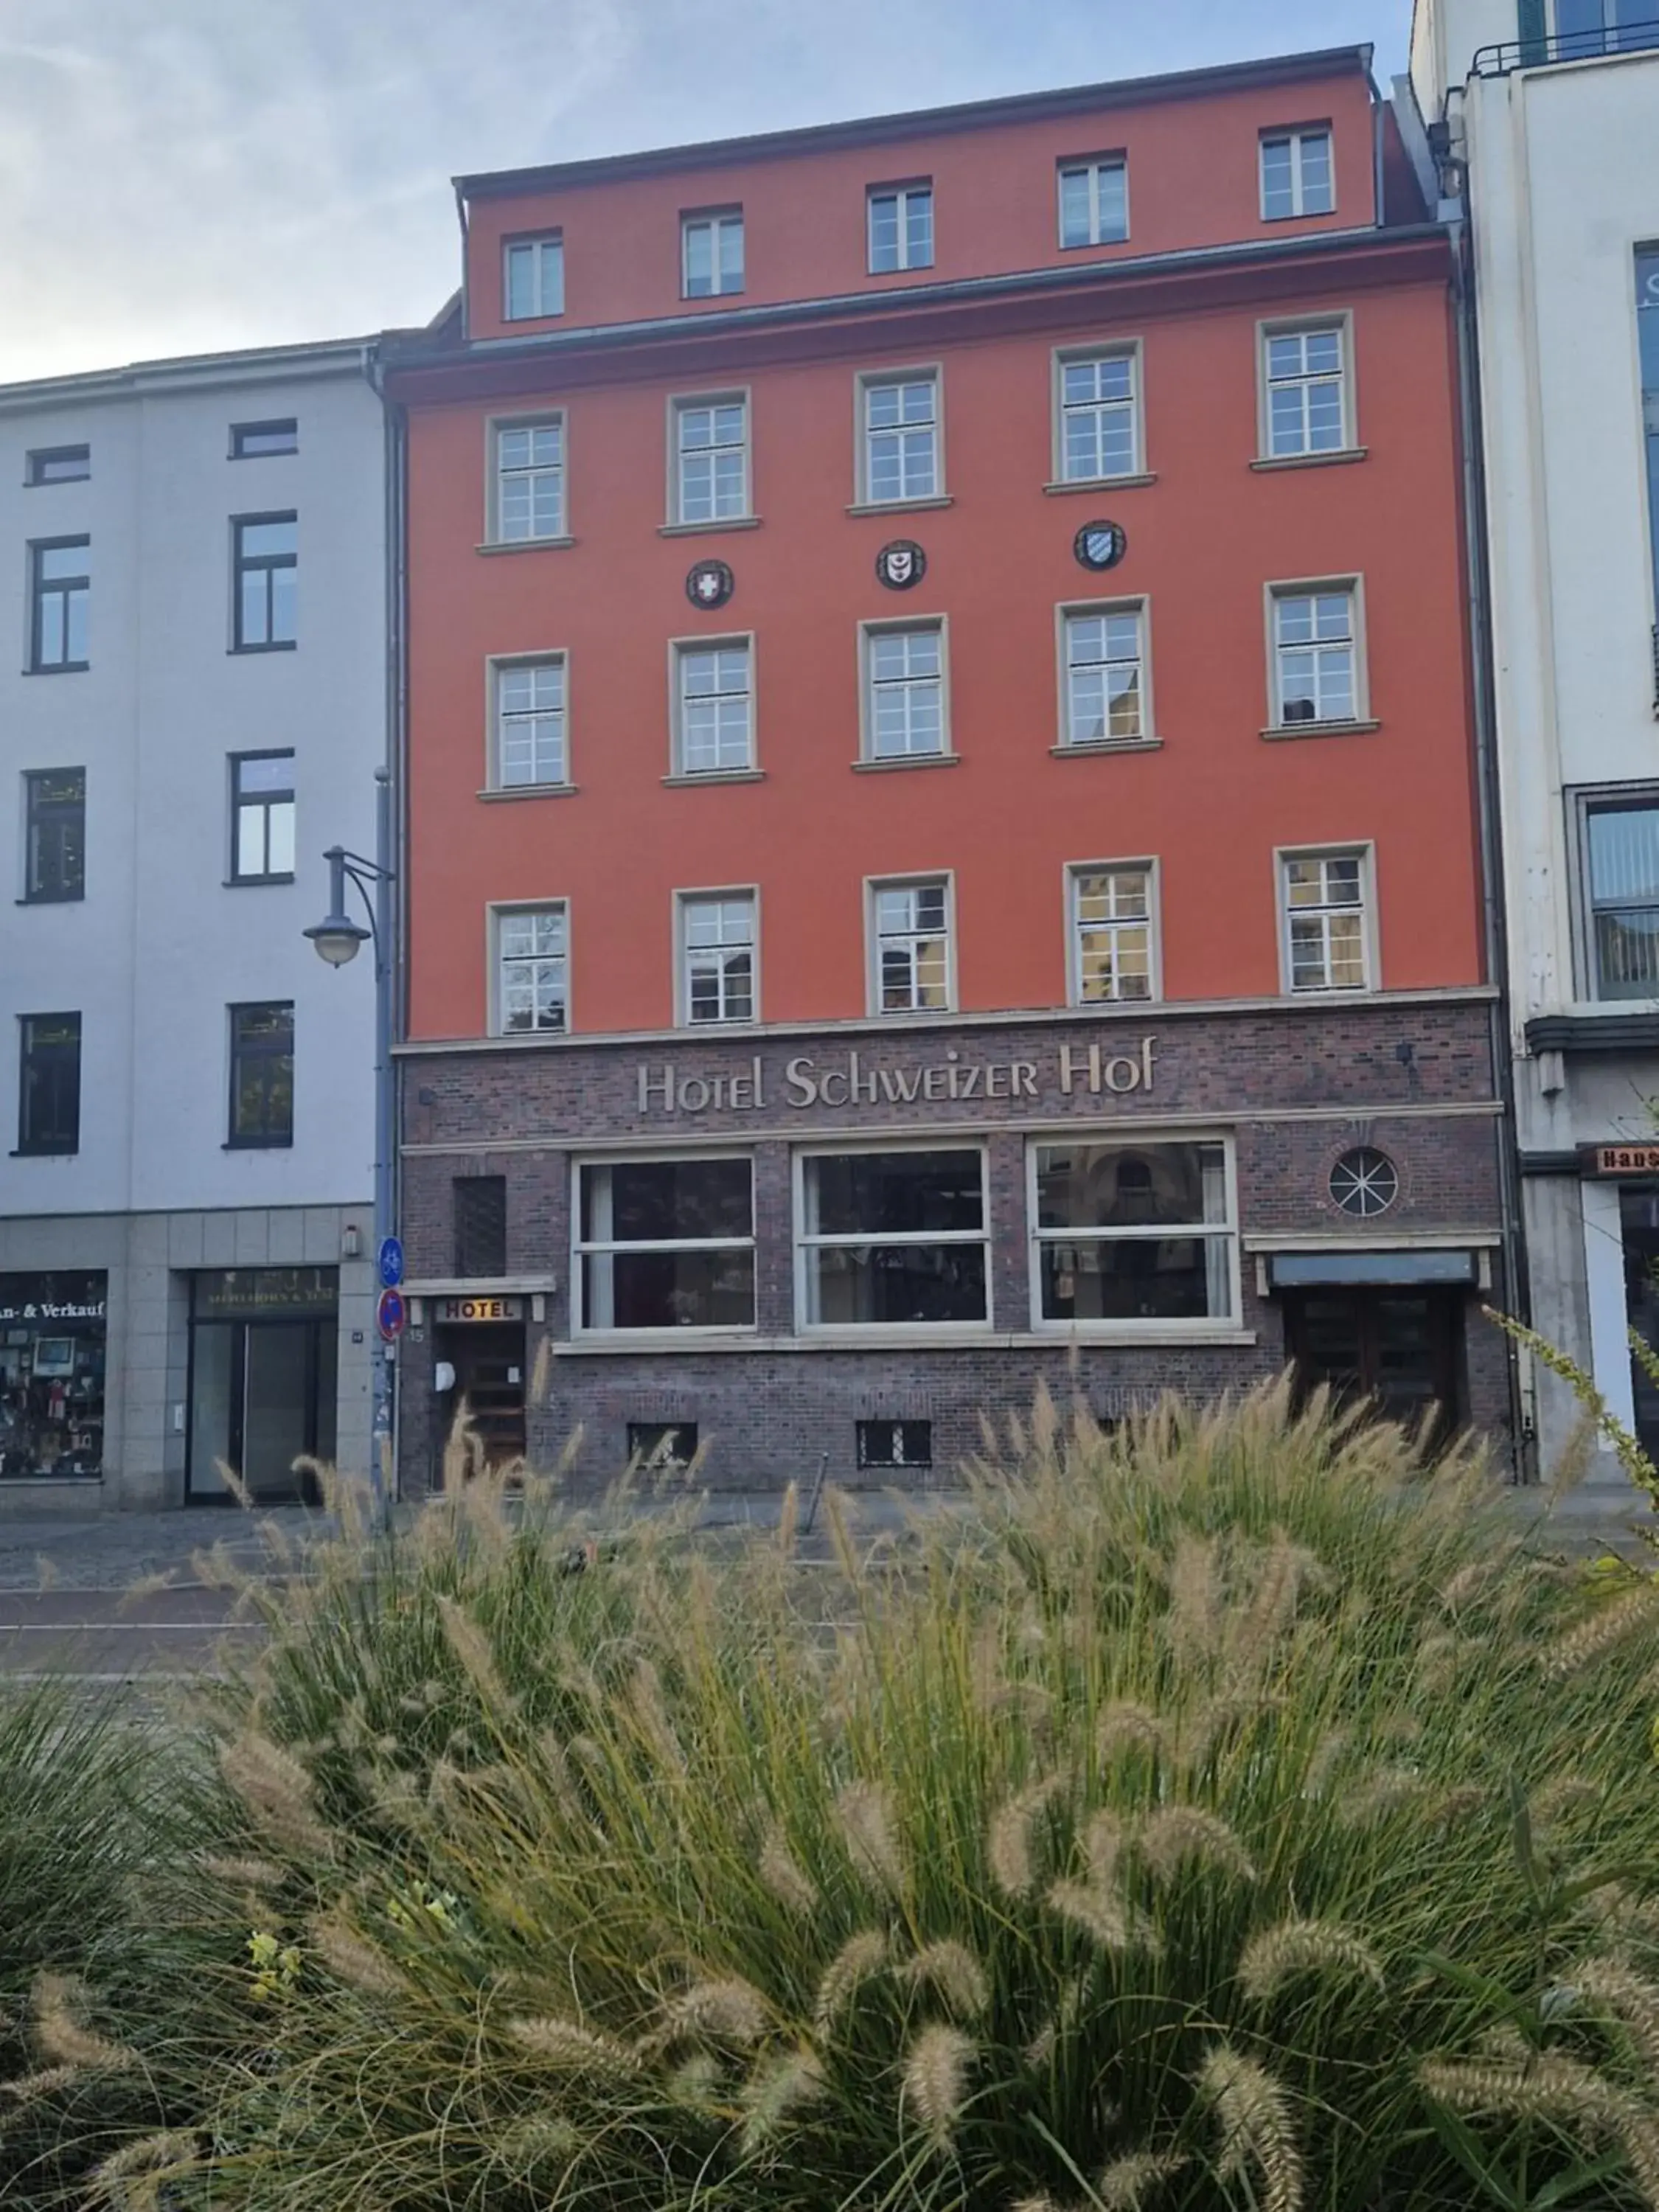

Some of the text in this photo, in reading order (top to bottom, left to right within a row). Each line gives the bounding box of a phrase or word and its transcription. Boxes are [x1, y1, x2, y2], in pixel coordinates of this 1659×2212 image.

[1060, 1035, 1159, 1094] Hof
[23, 1304, 37, 1318] &
[41, 1301, 105, 1318] Verkauf
[445, 1300, 514, 1318] HOTEL
[409, 1329, 425, 1343] 15
